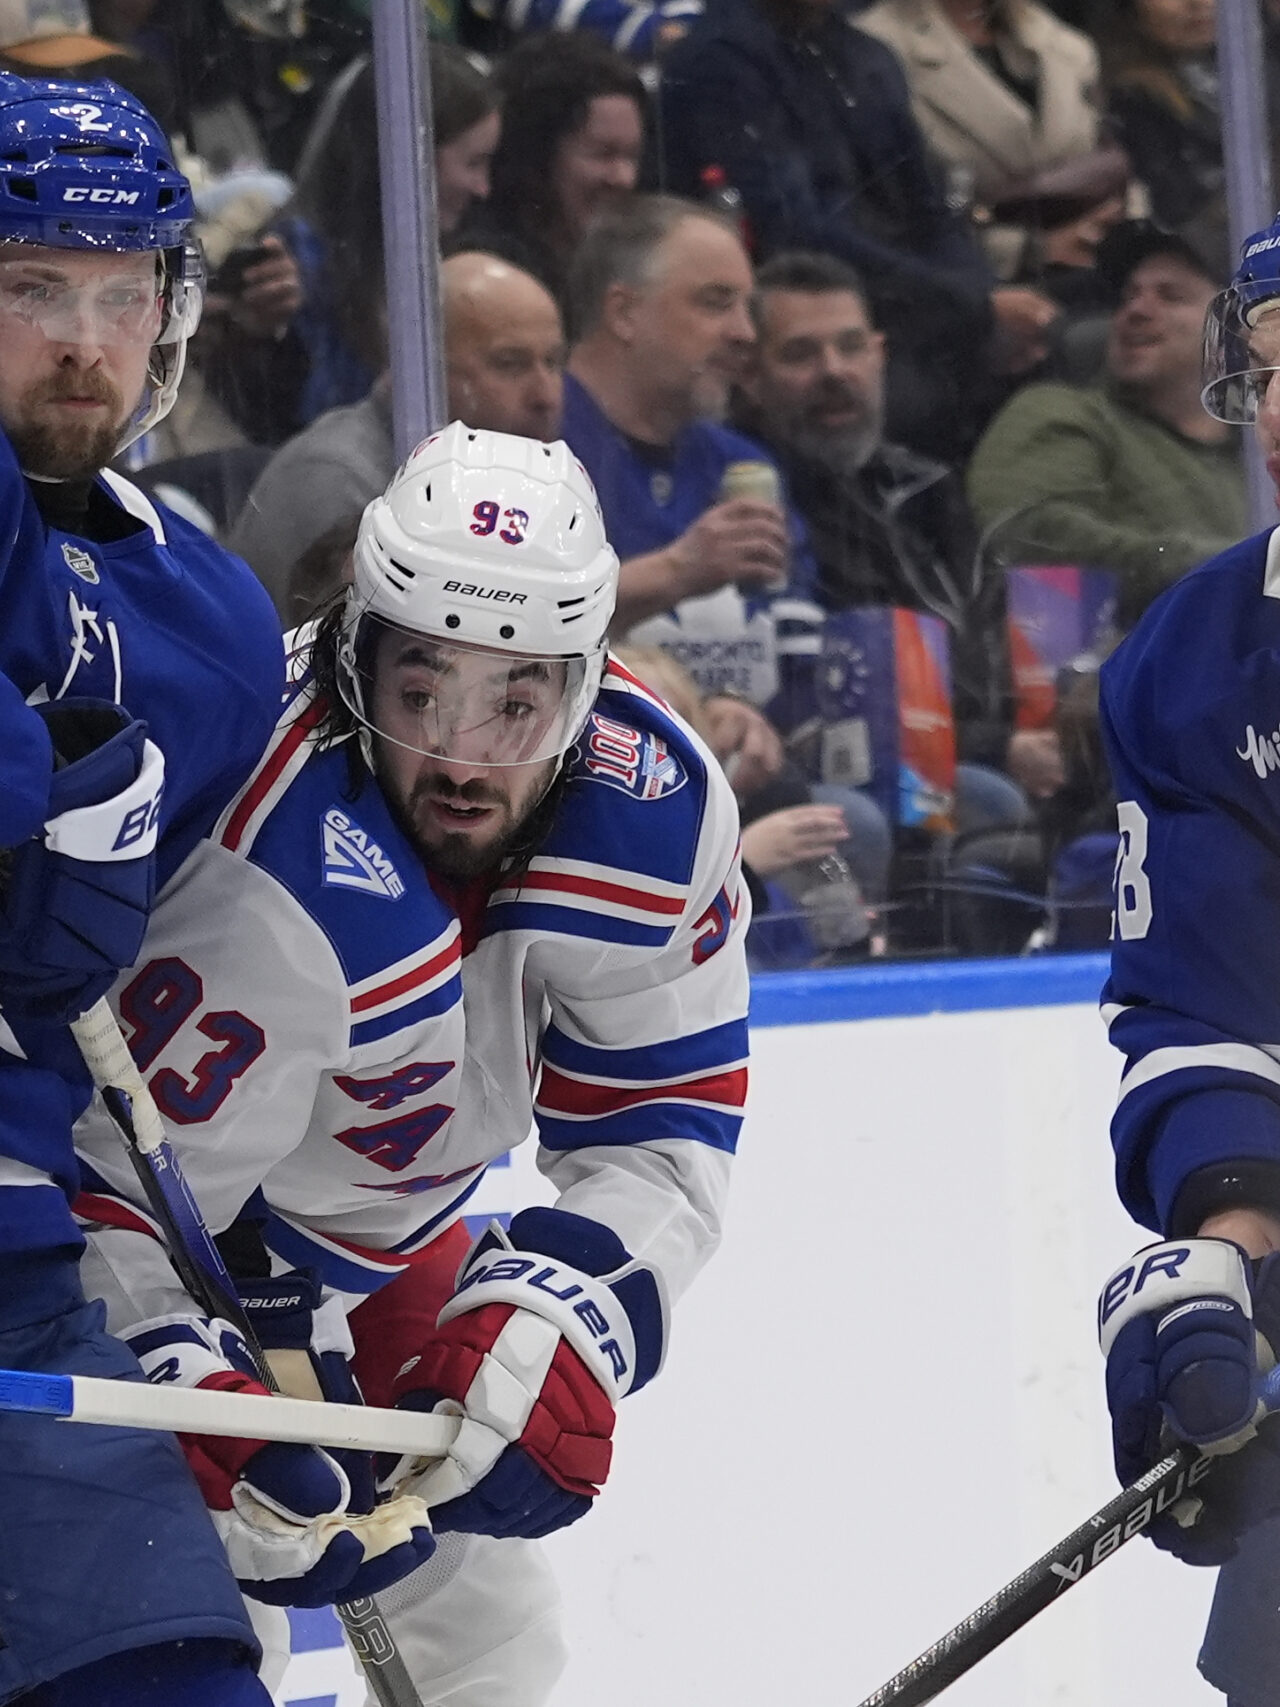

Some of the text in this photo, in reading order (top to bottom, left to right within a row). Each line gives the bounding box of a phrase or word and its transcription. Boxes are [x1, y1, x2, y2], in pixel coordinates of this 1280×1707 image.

[71, 103, 110, 132] 2
[63, 187, 140, 206] CCM
[469, 500, 530, 546] 93
[442, 580, 528, 605] BAUER
[1236, 722, 1280, 779] Mi
[325, 809, 405, 899] GAME
[1109, 800, 1153, 941] 8
[117, 957, 266, 1125] 93
[1091, 1455, 1214, 1567] BAUE
